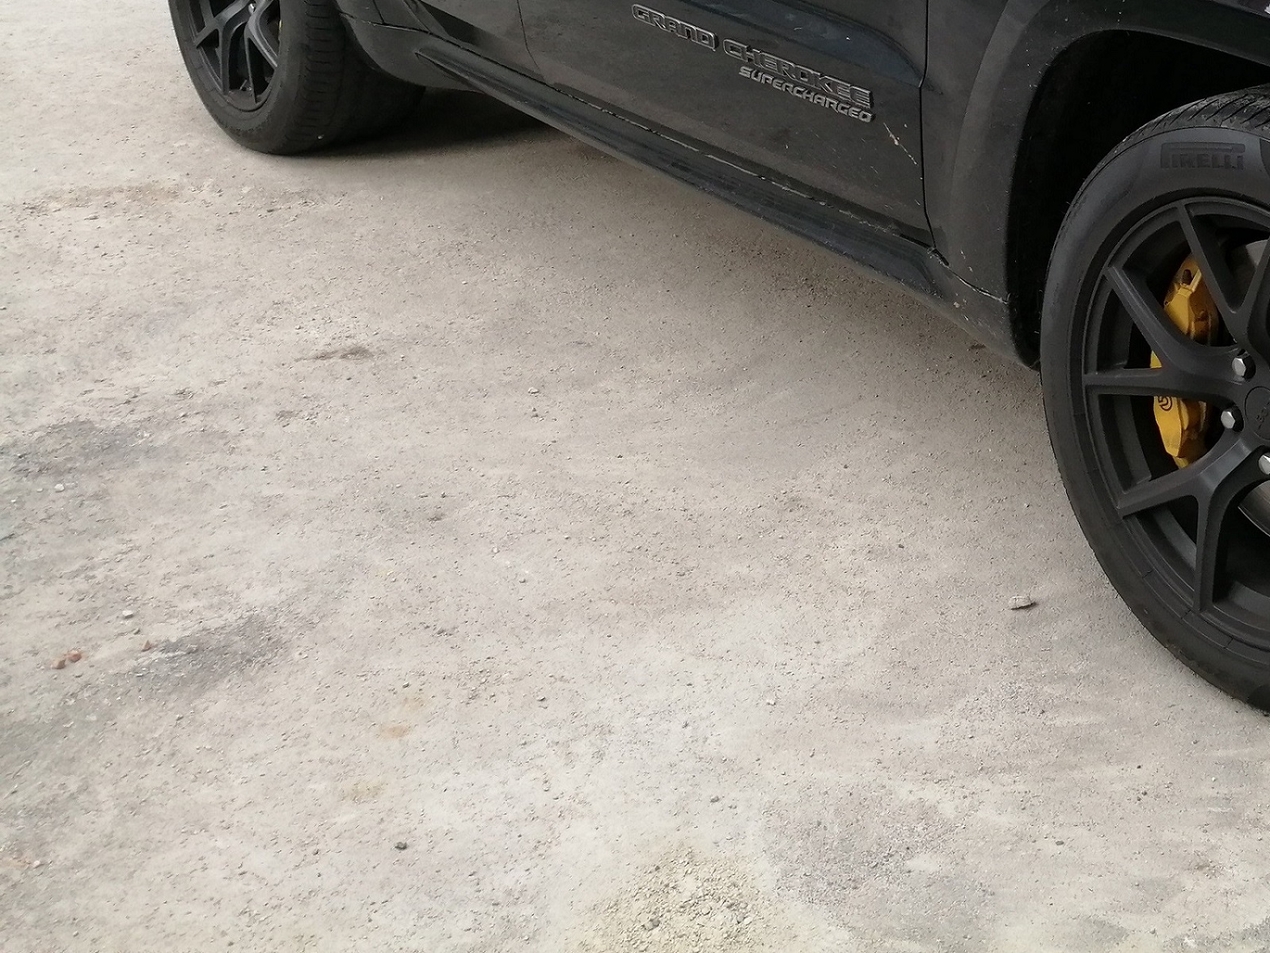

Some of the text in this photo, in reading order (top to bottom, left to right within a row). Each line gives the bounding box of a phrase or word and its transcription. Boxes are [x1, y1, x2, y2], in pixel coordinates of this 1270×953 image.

[631, 3, 719, 52] GRAND
[723, 39, 874, 109] CHEROKEE
[738, 65, 876, 123] SUPERCHARGED
[1160, 141, 1246, 170] PIRELLI
